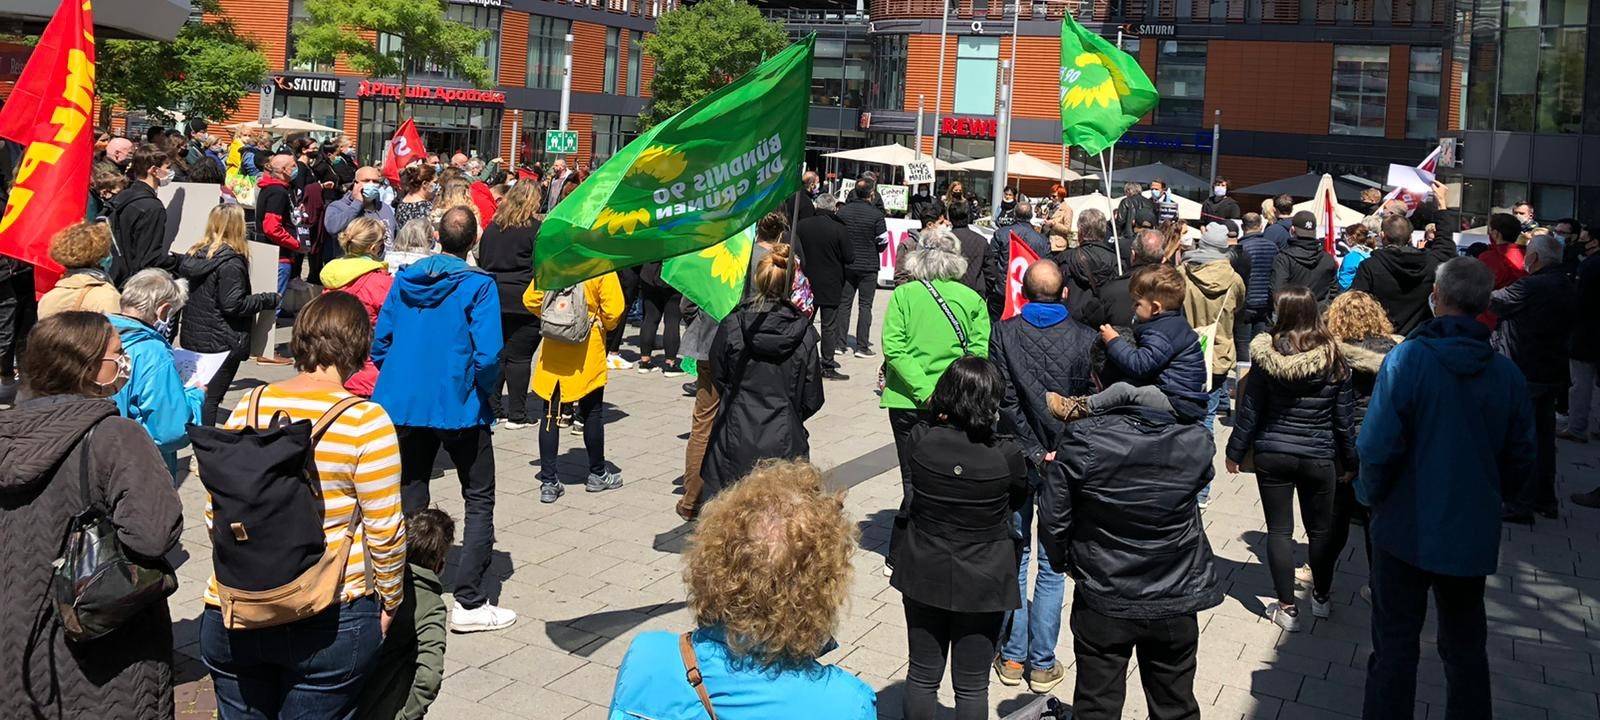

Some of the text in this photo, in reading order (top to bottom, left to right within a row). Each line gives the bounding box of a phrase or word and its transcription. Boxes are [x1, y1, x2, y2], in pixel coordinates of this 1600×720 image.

[1140, 24, 1174, 35] SATURN
[293, 78, 336, 93] SATURN
[371, 81, 507, 104] Pinguin Apotheke
